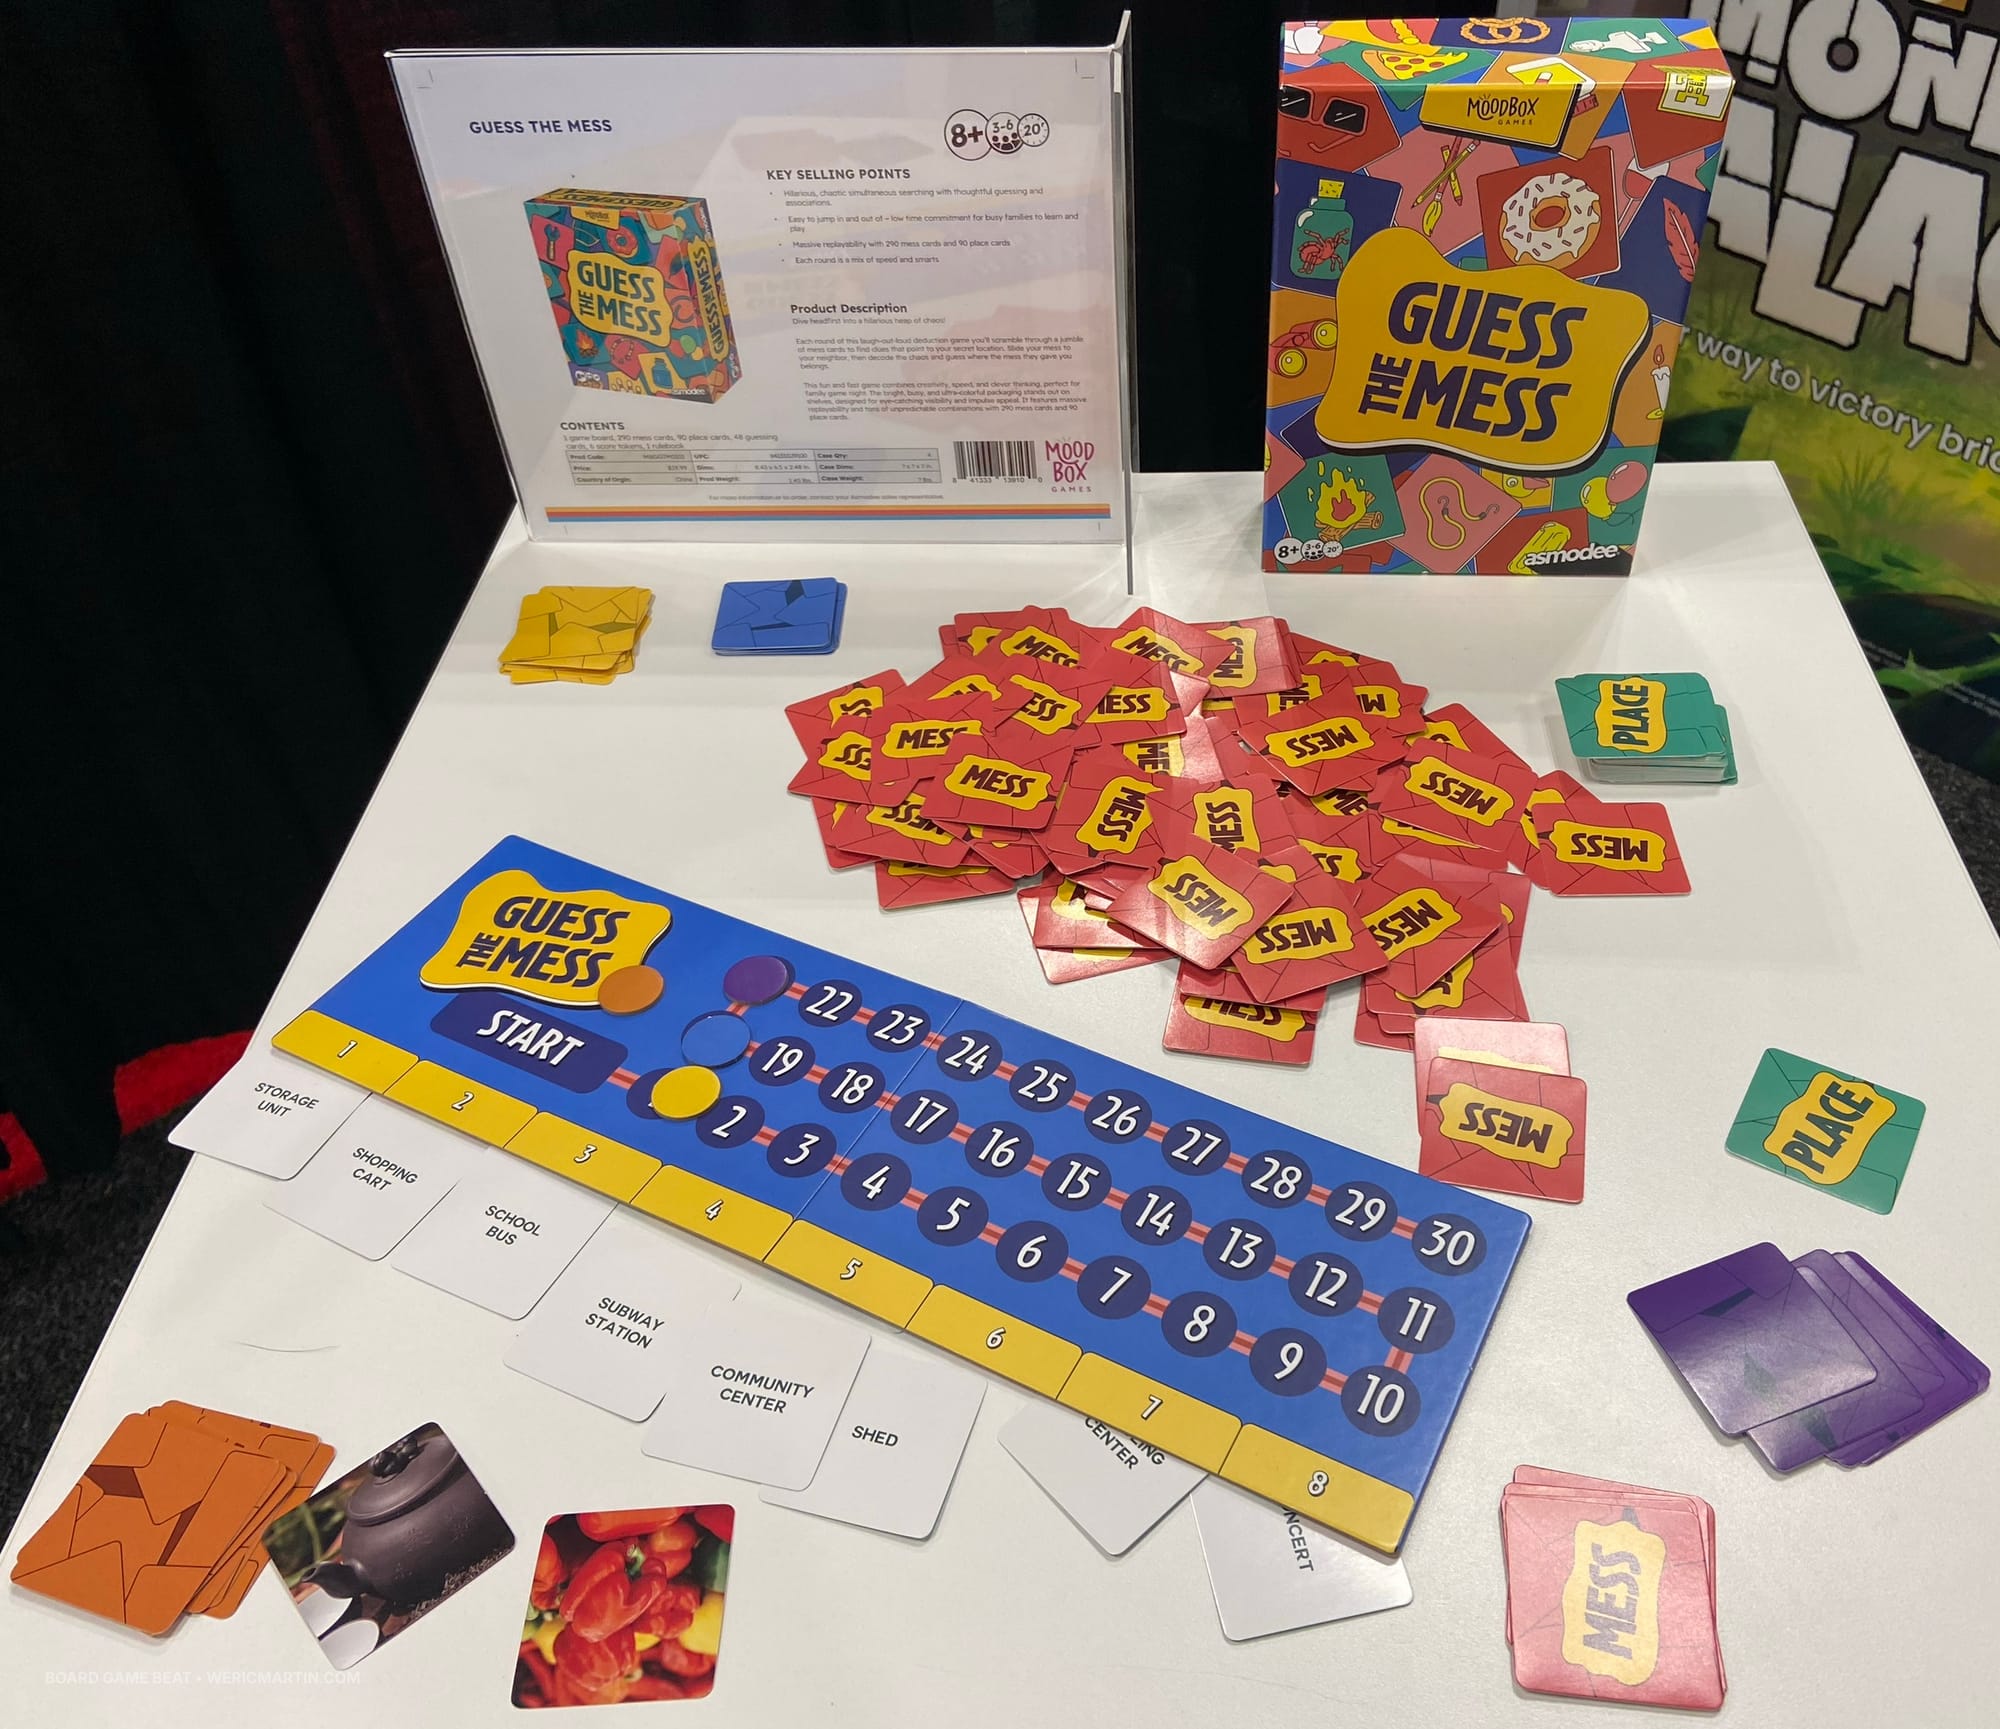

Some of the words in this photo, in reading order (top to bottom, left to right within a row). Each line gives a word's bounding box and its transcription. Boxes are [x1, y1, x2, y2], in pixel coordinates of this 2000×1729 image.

[1690, 0, 2000, 157] MON
[470, 121, 524, 134] GUESS
[529, 121, 563, 133] THE
[568, 119, 613, 132] MESS
[1467, 97, 1540, 121] MOODBOX
[951, 124, 983, 147] 8+
[993, 120, 1013, 133] 3-6
[767, 170, 792, 180] KEY
[797, 170, 855, 180] SELLING
[859, 169, 911, 179] POINTS
[899, 189, 934, 198] searching
[935, 188, 952, 196] with
[954, 188, 992, 197] thoughtful
[994, 189, 1027, 197] guessing
[817, 216, 836, 224] jump
[924, 214, 970, 222] commitment
[985, 214, 1002, 223] busy
[1005, 213, 1033, 221] families
[1035, 213, 1043, 221] to
[1045, 213, 1063, 221] learn
[1064, 212, 1079, 220] and
[815, 256, 836, 264] round
[876, 256, 899, 265] speed
[915, 255, 940, 263] smarts
[823, 240, 866, 250] replayability
[886, 239, 899, 247] 290
[943, 239, 957, 247] and
[958, 239, 968, 247] 90
[970, 239, 990, 248] place
[577, 260, 656, 304] GUESS
[580, 290, 594, 317] THE
[597, 294, 662, 336] MESS
[791, 304, 836, 313] Product
[841, 303, 907, 315] Description
[1388, 282, 1587, 369] GUESS
[1358, 353, 1412, 415] THE
[1403, 361, 1571, 442] MESS
[1697, 330, 1764, 381] way
[1769, 358, 1801, 393] to
[1811, 377, 1932, 450] victory
[560, 422, 625, 431] CONTENTS
[1045, 441, 1094, 465] MOOD
[1053, 461, 1088, 483] BOX
[1278, 545, 1299, 558] 8+
[1524, 543, 1618, 569] asmodee
[1018, 692, 1067, 721] ESS
[1612, 683, 1648, 746] PLACE
[1286, 725, 1358, 759] MESS
[960, 765, 1036, 798] MESS
[1420, 772, 1498, 815] MESS
[1097, 787, 1145, 842] MESS
[1571, 833, 1648, 862] MESS
[1163, 873, 1238, 927] MESS
[493, 896, 630, 944] GUESS
[1255, 918, 1337, 954] MESS
[1367, 899, 1443, 951] MESS
[457, 932, 501, 968] THE
[493, 936, 614, 988] MESS
[805, 985, 853, 1021] 22
[477, 1010, 585, 1065] START
[874, 1011, 924, 1044] 23
[337, 1040, 356, 1058] 1
[762, 1042, 803, 1077] 19
[945, 1036, 989, 1074] 24
[254, 1082, 319, 1111] STORAGE
[452, 1092, 474, 1110] 2
[831, 1068, 873, 1104] 18
[1018, 1066, 1067, 1102] 25
[257, 1100, 291, 1119] UNIT
[711, 1106, 748, 1138] 2
[904, 1097, 948, 1134] 17
[1092, 1097, 1138, 1134] 26
[1781, 1081, 1874, 1174] PLACE
[1460, 1103, 1554, 1153] MESS
[574, 1144, 597, 1163] 3
[784, 1134, 820, 1166] 3
[979, 1129, 1020, 1167] 16
[1172, 1128, 1221, 1166] 27
[352, 1168, 391, 1192] CART
[353, 1147, 418, 1185] SHOPPING
[862, 1165, 891, 1200] 4
[1057, 1161, 1099, 1201] 15
[1251, 1158, 1302, 1199] 28
[485, 1204, 541, 1237] SCHOOL
[704, 1200, 723, 1220] 4
[936, 1197, 971, 1231] 5
[1136, 1193, 1175, 1237] 14
[1335, 1189, 1386, 1232] 29
[486, 1226, 518, 1246] BUS
[1017, 1235, 1047, 1269] 6
[1219, 1227, 1263, 1270] 13
[1420, 1224, 1475, 1266] 30
[840, 1259, 862, 1279] 5
[1099, 1267, 1131, 1303] 7
[1304, 1261, 1348, 1306] 12
[584, 1312, 653, 1350] STATION
[598, 1296, 664, 1334] SUBWAY
[1184, 1306, 1215, 1342] 8
[1399, 1297, 1437, 1341] 11
[986, 1326, 1005, 1349] 6
[1274, 1342, 1303, 1380] 9
[711, 1364, 814, 1400] COMMUNITY
[1357, 1374, 1405, 1423] 10
[719, 1386, 786, 1415] CENTER
[1140, 1395, 1163, 1420] 7
[852, 1424, 899, 1447] SHED
[1085, 1417, 1138, 1470] CENTER
[1307, 1471, 1329, 1496] 8
[1281, 1506, 1314, 1571] NCERT
[1582, 1544, 1643, 1659] MESS
